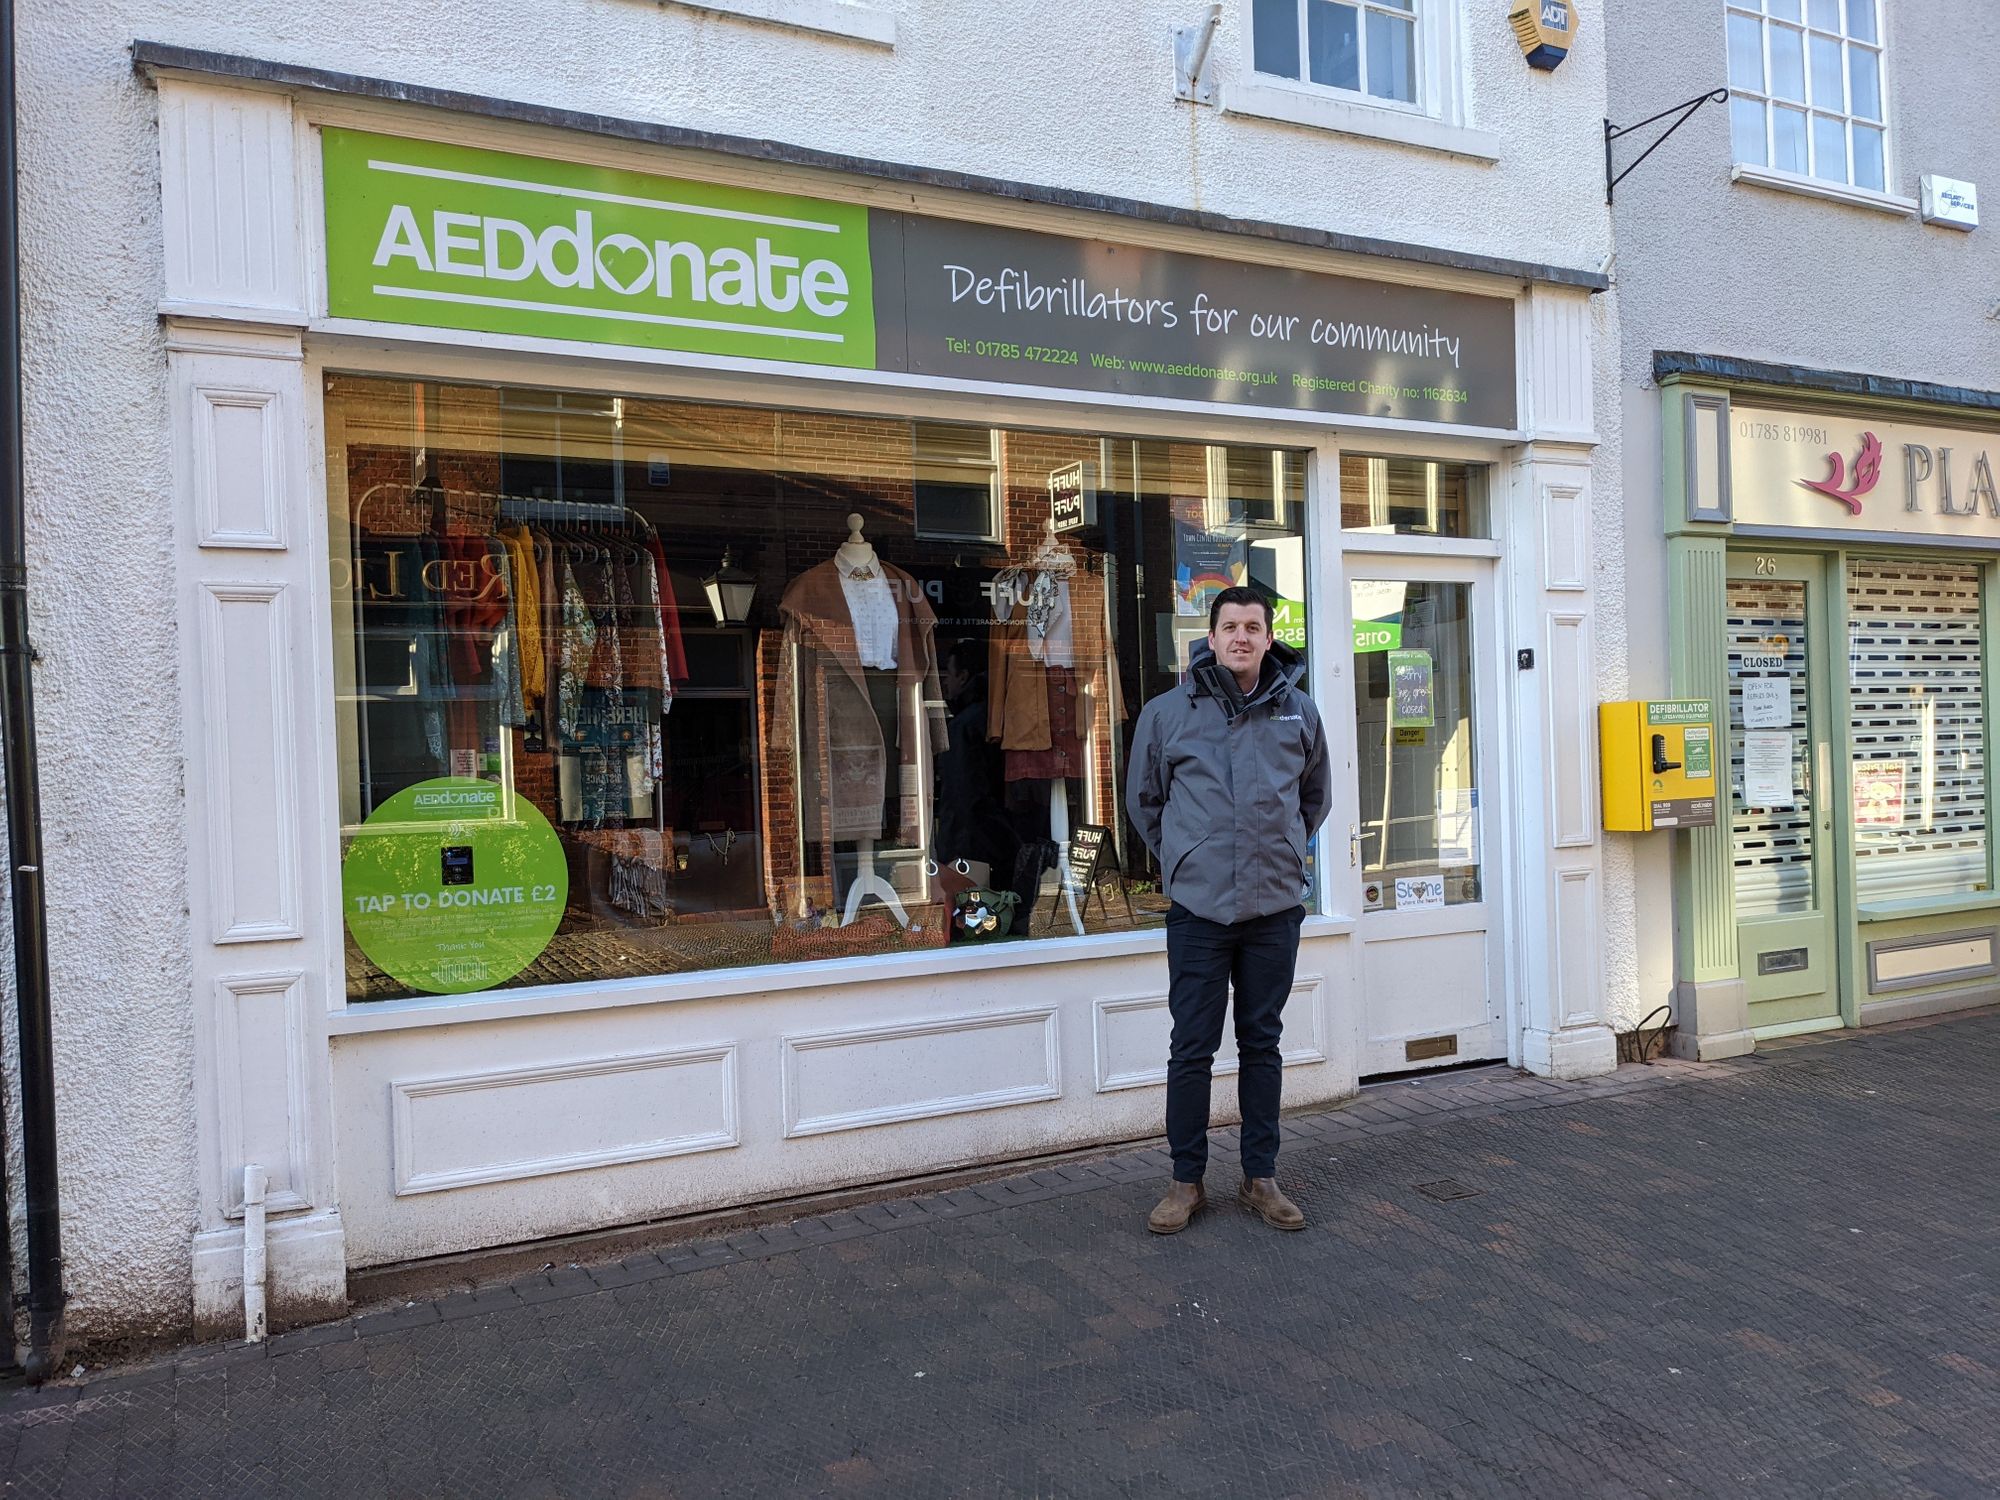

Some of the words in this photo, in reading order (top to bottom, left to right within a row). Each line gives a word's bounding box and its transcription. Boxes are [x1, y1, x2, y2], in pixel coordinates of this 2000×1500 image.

[1542, 4, 1568, 25] ADT
[372, 204, 849, 318] AEDdonate
[943, 264, 1178, 329] Defibrillators
[1189, 293, 1238, 336] for
[1250, 313, 1300, 341] our
[1310, 318, 1460, 369] community
[945, 337, 971, 354] Tel:
[975, 340, 1021, 359] 01785
[1024, 346, 1079, 366] 472224
[1090, 353, 1126, 371] Web:
[1129, 359, 1278, 386] www.aeddonate.org.uk
[1292, 373, 1356, 393] Registered
[1359, 380, 1400, 400] Charity
[1403, 388, 1420, 399] no:
[1422, 386, 1468, 404] 1162634
[1740, 421, 1780, 441] 01785
[1783, 425, 1829, 446] 819981
[1755, 556, 1777, 576] 26
[1743, 656, 1783, 668] CLOSED
[1650, 703, 1709, 714] DEFIBRILLATOR
[413, 789, 496, 806] AEDdonate
[355, 895, 395, 913] TAP
[400, 893, 431, 911] TO
[438, 887, 524, 909] DONATE
[531, 885, 556, 902] £2
